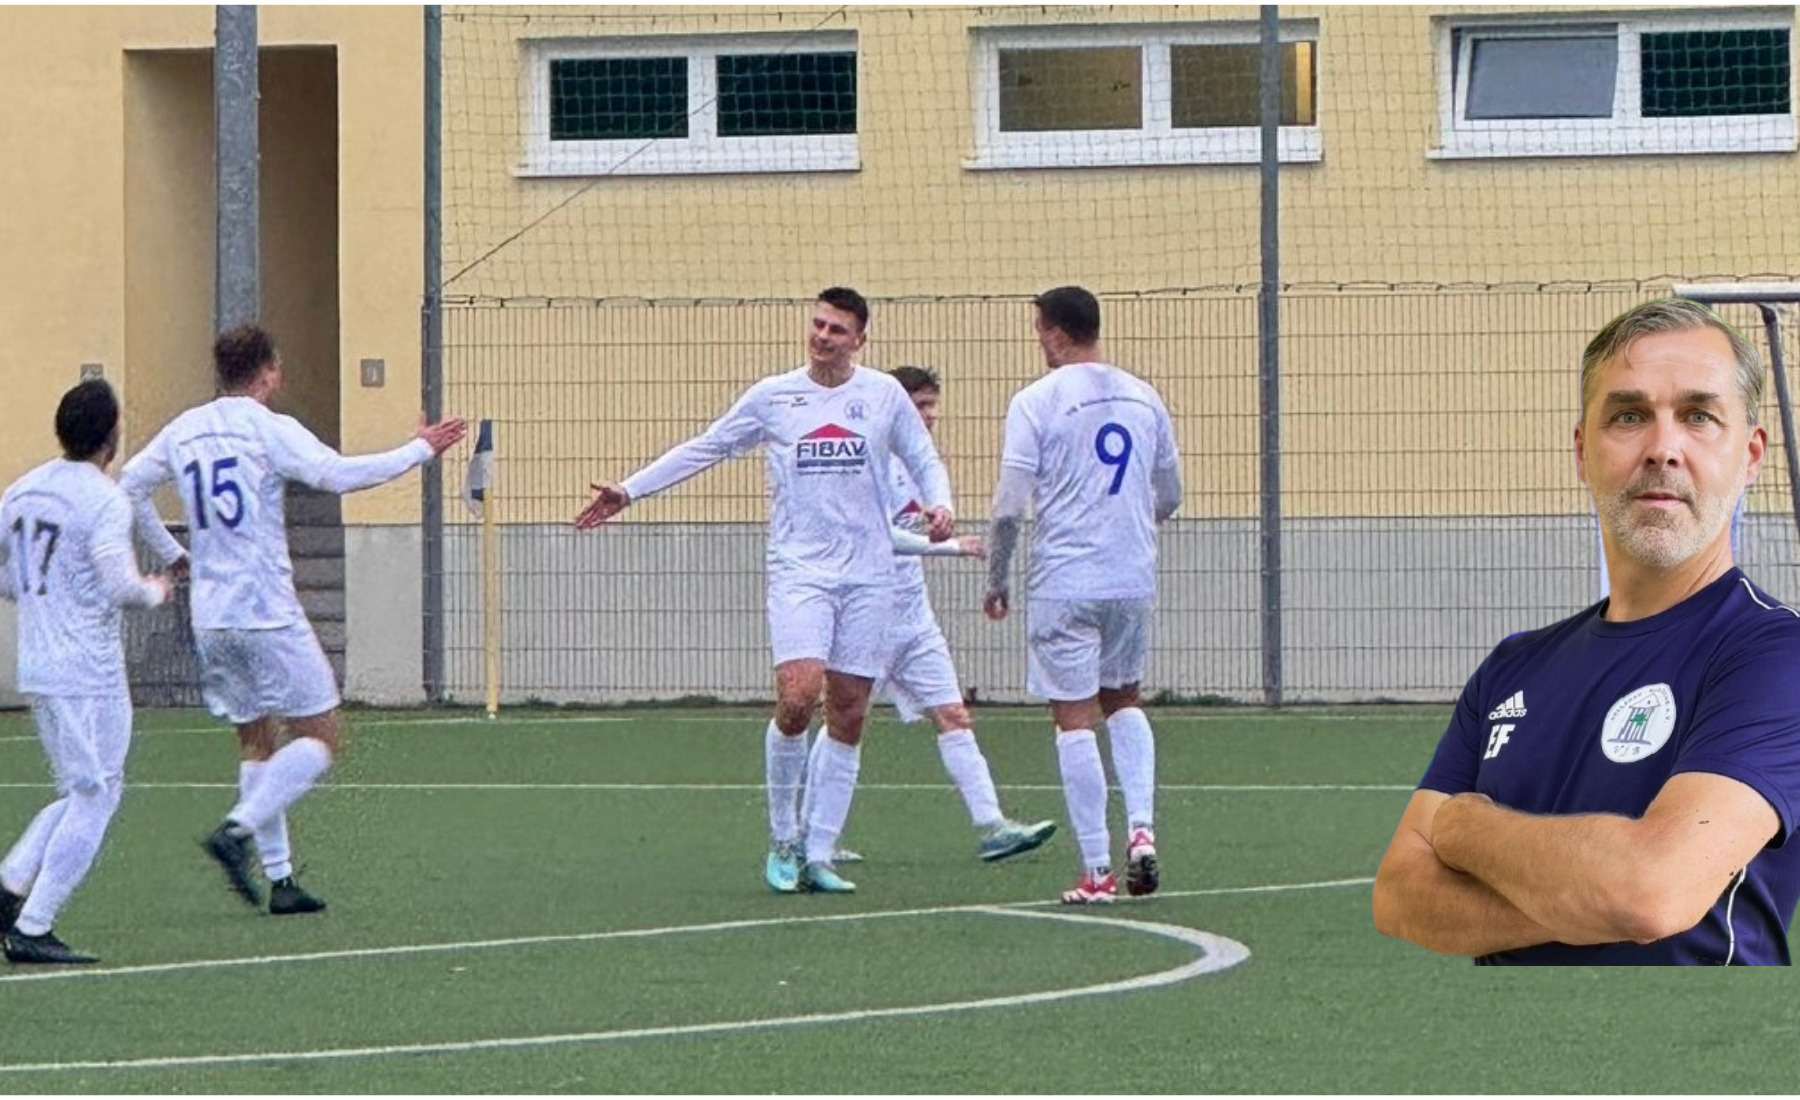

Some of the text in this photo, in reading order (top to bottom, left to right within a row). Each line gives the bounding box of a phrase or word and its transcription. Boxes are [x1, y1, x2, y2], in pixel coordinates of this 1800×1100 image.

[797, 441, 865, 457] FIBAV
[1094, 422, 1132, 495] 9
[184, 456, 244, 529] 15
[11, 516, 60, 595] 17
[1488, 708, 1527, 720] adidas
[1483, 724, 1516, 759] EF
